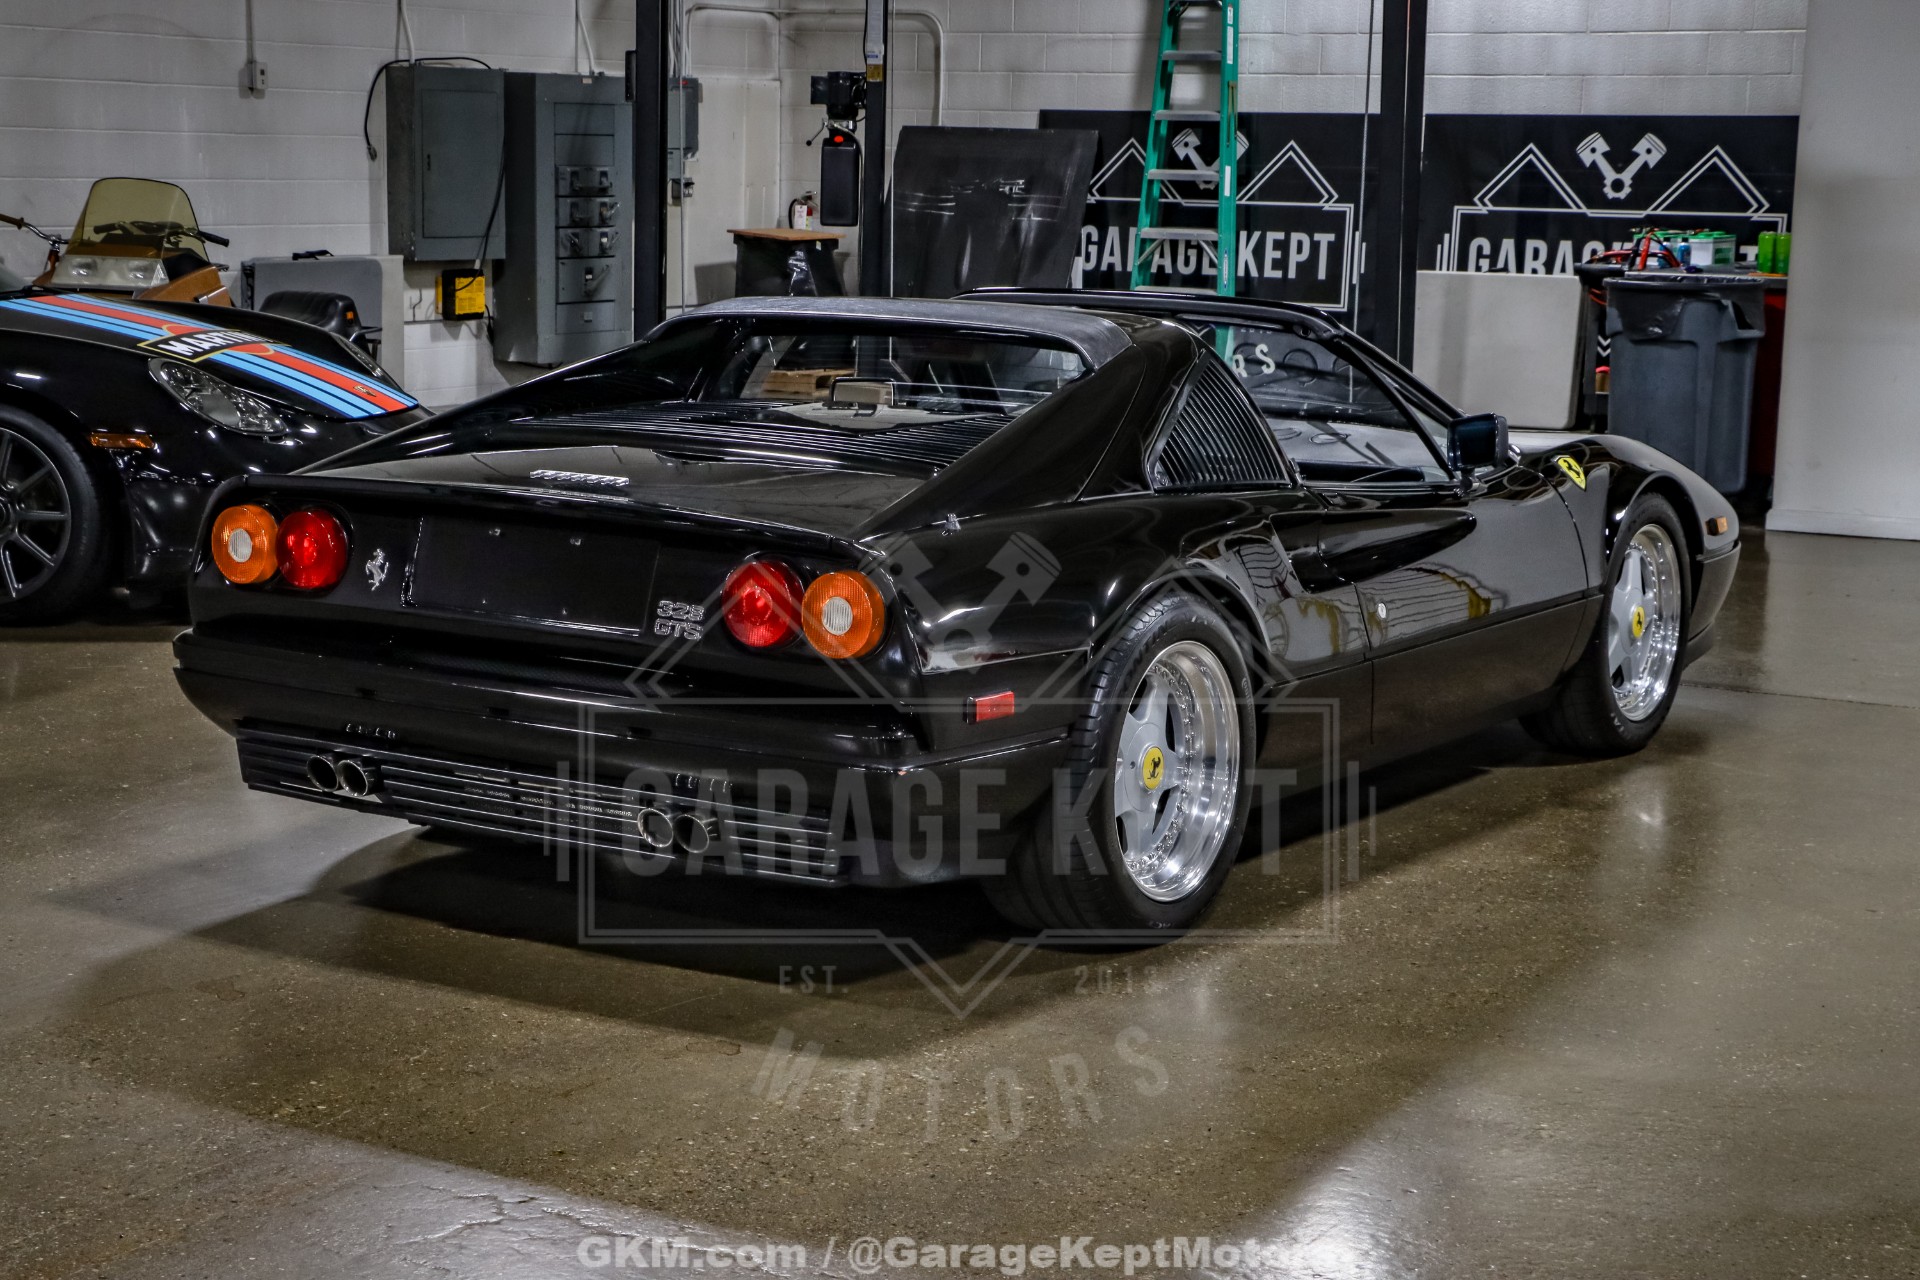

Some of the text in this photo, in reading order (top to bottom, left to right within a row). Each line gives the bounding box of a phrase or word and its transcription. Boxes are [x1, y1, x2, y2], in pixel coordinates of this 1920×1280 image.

[1237, 230, 1335, 280] KEPT
[1467, 237, 1633, 276] GARA
[656, 600, 704, 620] 328
[654, 618, 703, 639] GTS
